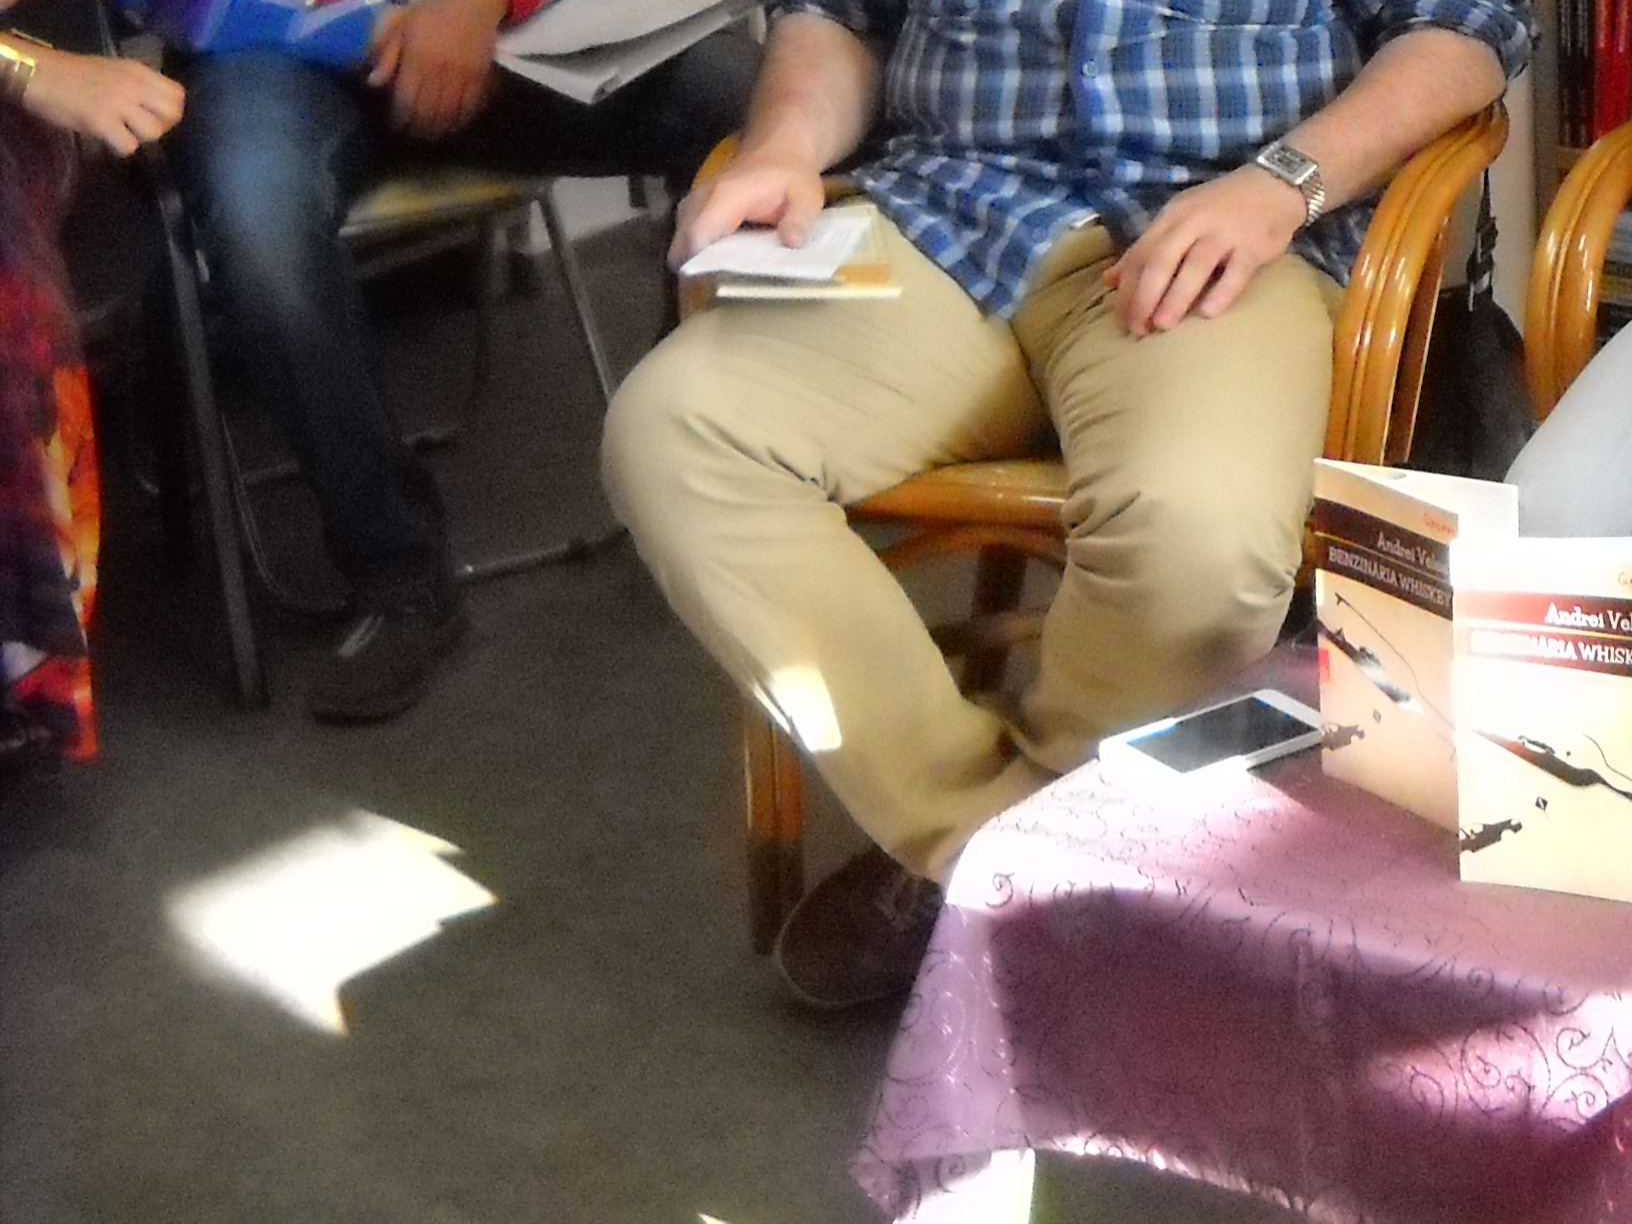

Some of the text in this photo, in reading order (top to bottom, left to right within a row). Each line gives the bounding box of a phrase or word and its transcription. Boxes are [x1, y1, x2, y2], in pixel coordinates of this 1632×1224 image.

[1377, 531, 1415, 563] Andrei
[1328, 545, 1450, 608] BENZINARIA WHISKEY
[1543, 601, 1605, 630] Andrei
